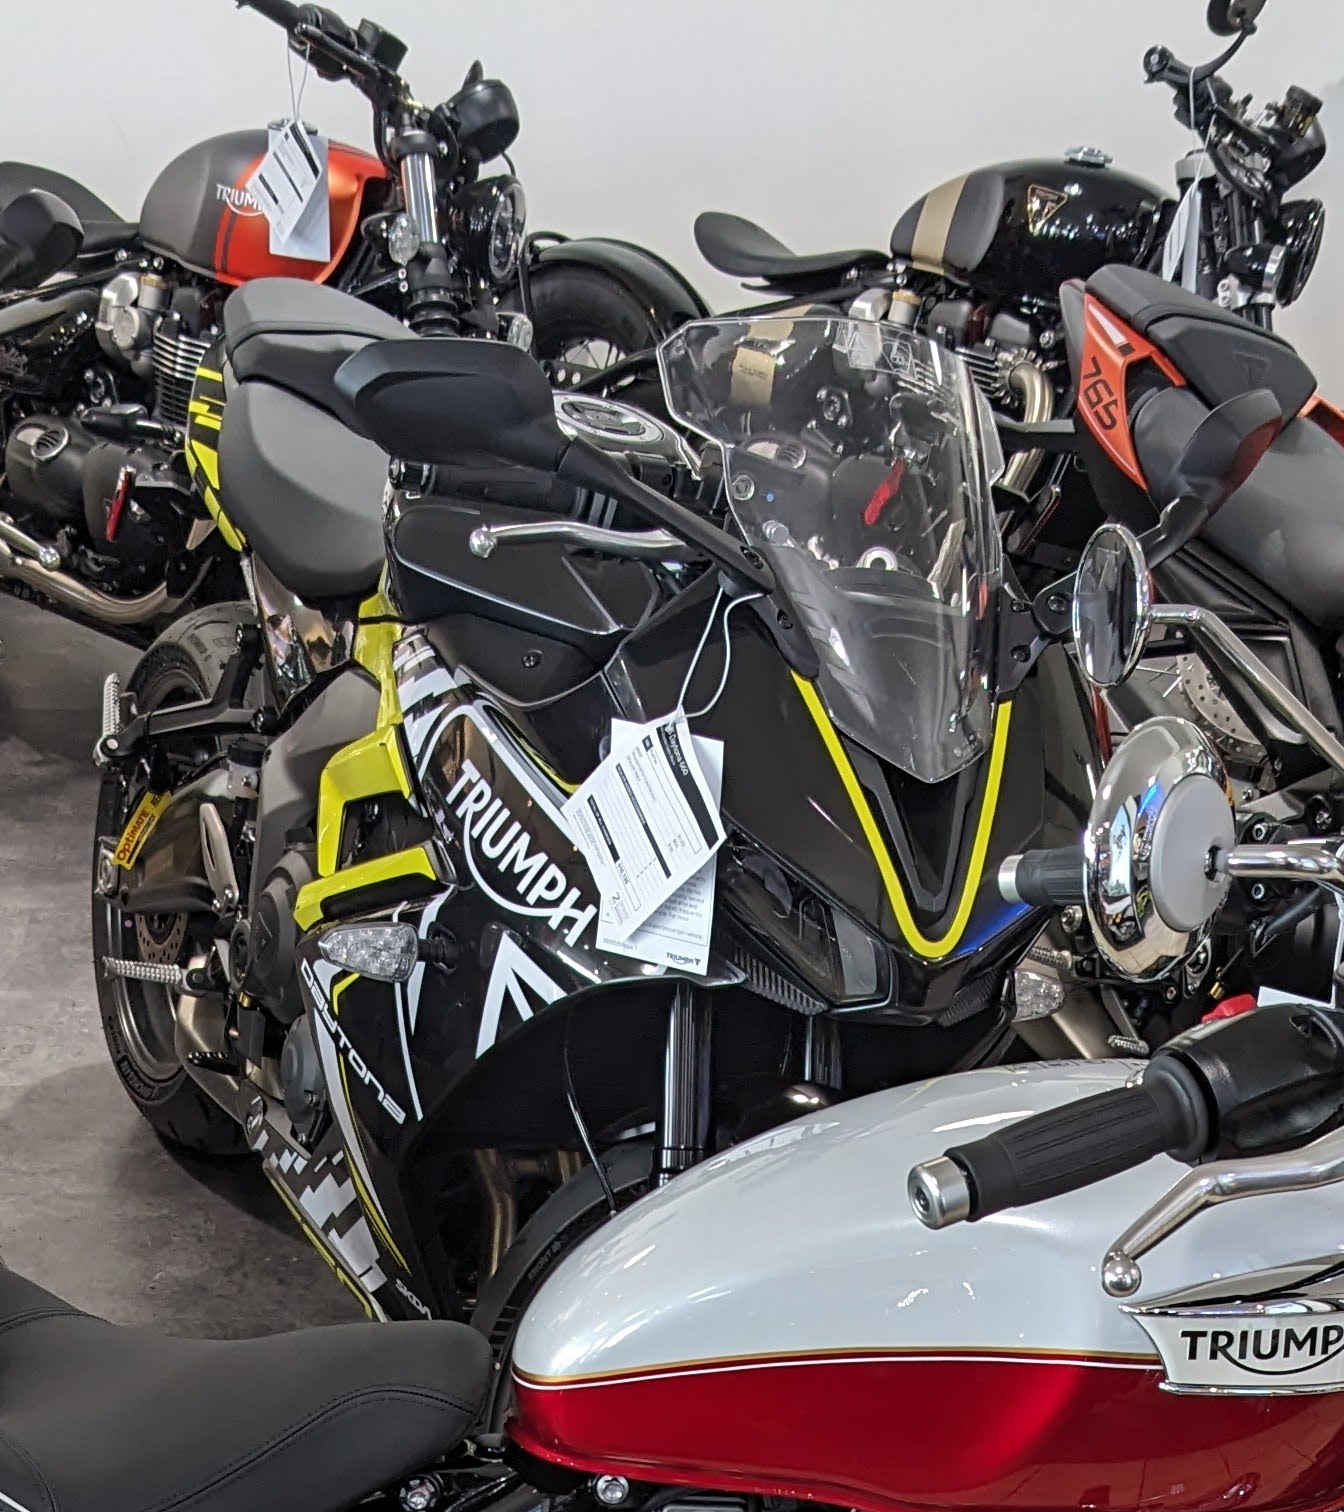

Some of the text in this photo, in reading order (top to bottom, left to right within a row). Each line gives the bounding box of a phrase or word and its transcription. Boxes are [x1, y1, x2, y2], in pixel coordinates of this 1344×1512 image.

[216, 183, 263, 216] TRIUM
[1083, 355, 1118, 430] 765
[665, 733, 689, 776] Daytona 660
[446, 758, 598, 947] TRIUMPH
[609, 890, 623, 905] 2
